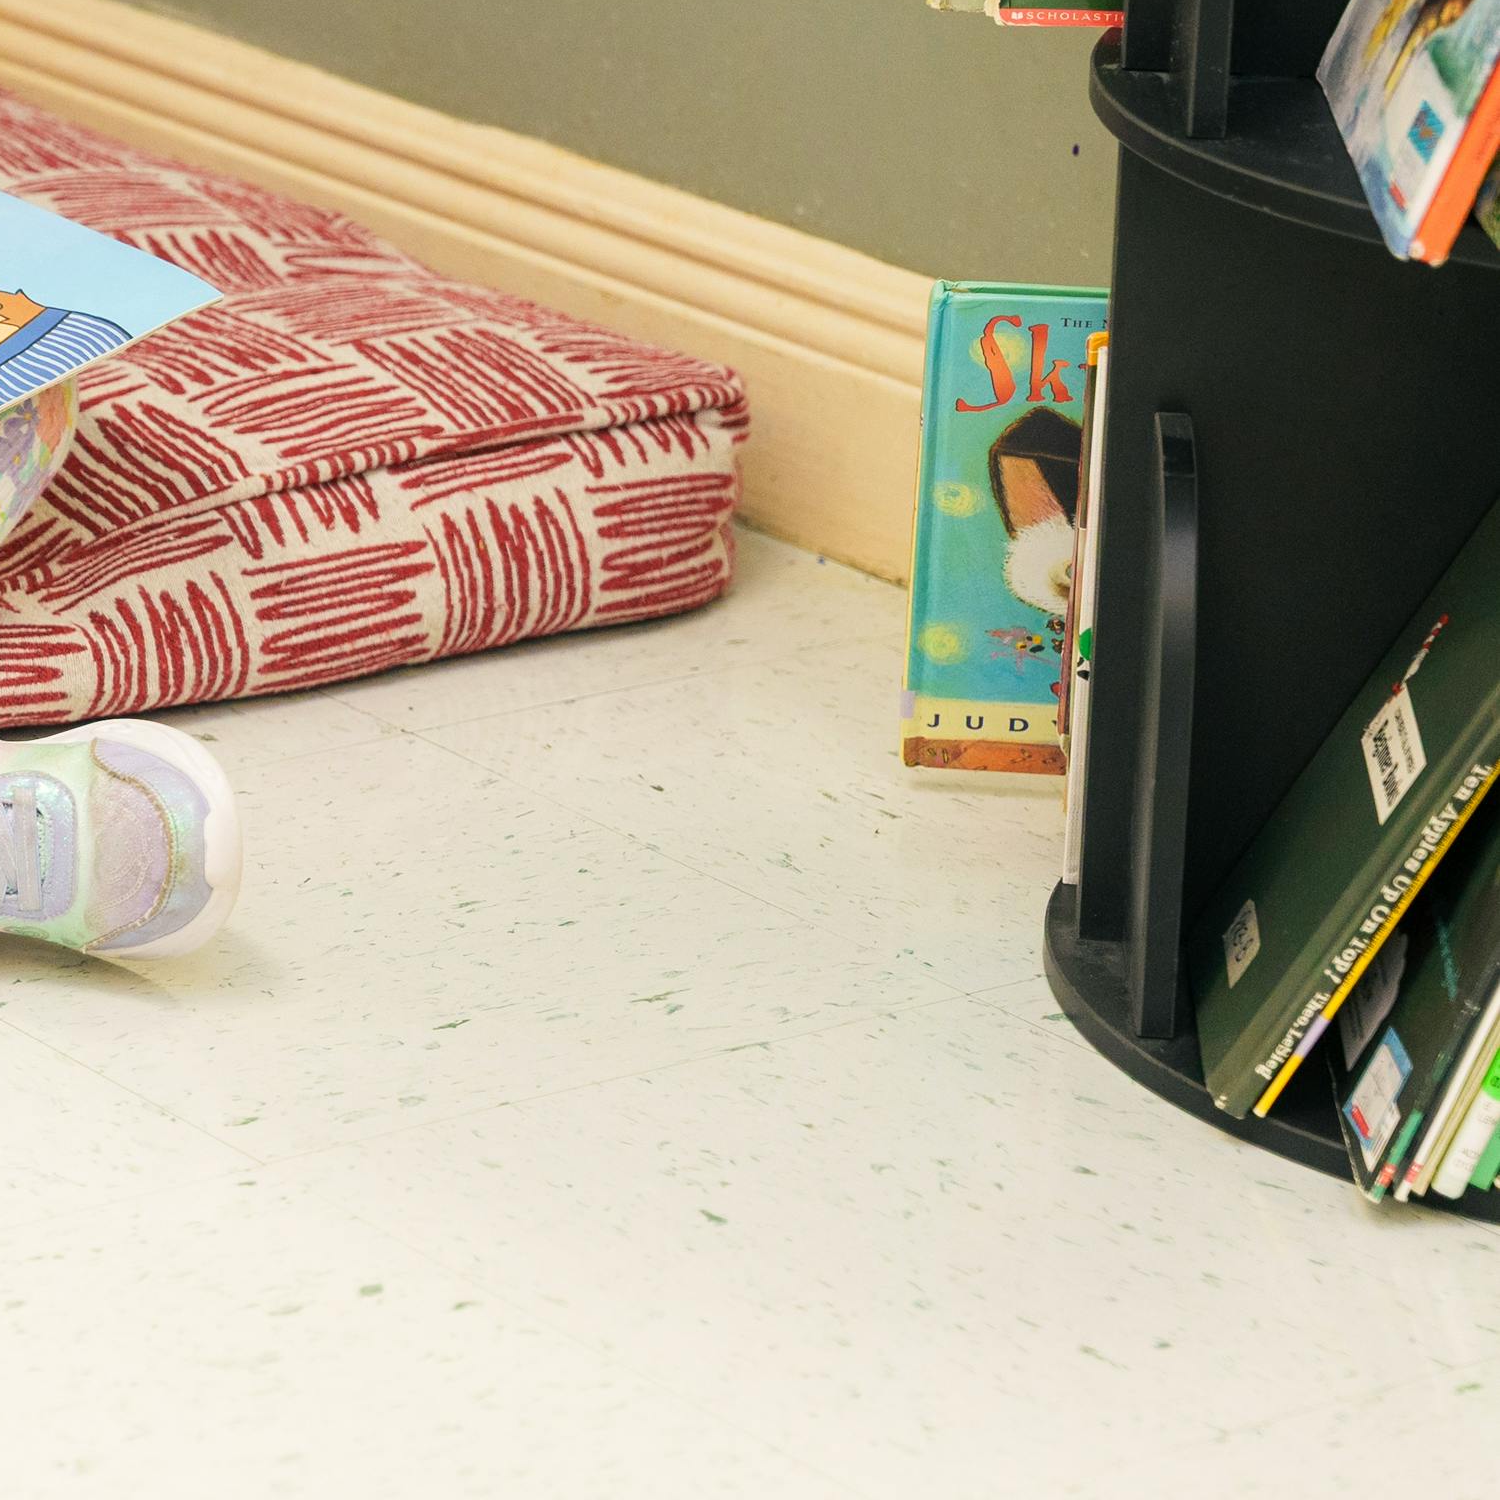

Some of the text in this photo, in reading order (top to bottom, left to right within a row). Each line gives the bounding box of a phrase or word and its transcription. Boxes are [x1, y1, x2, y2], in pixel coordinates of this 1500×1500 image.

[927, 713, 1057, 732] JUD
[1453, 763, 1491, 800] Ten
[1405, 803, 1460, 871] Apples
[1381, 873, 1412, 905] Up
[1359, 904, 1390, 936] On
[1324, 936, 1367, 985] Top!
